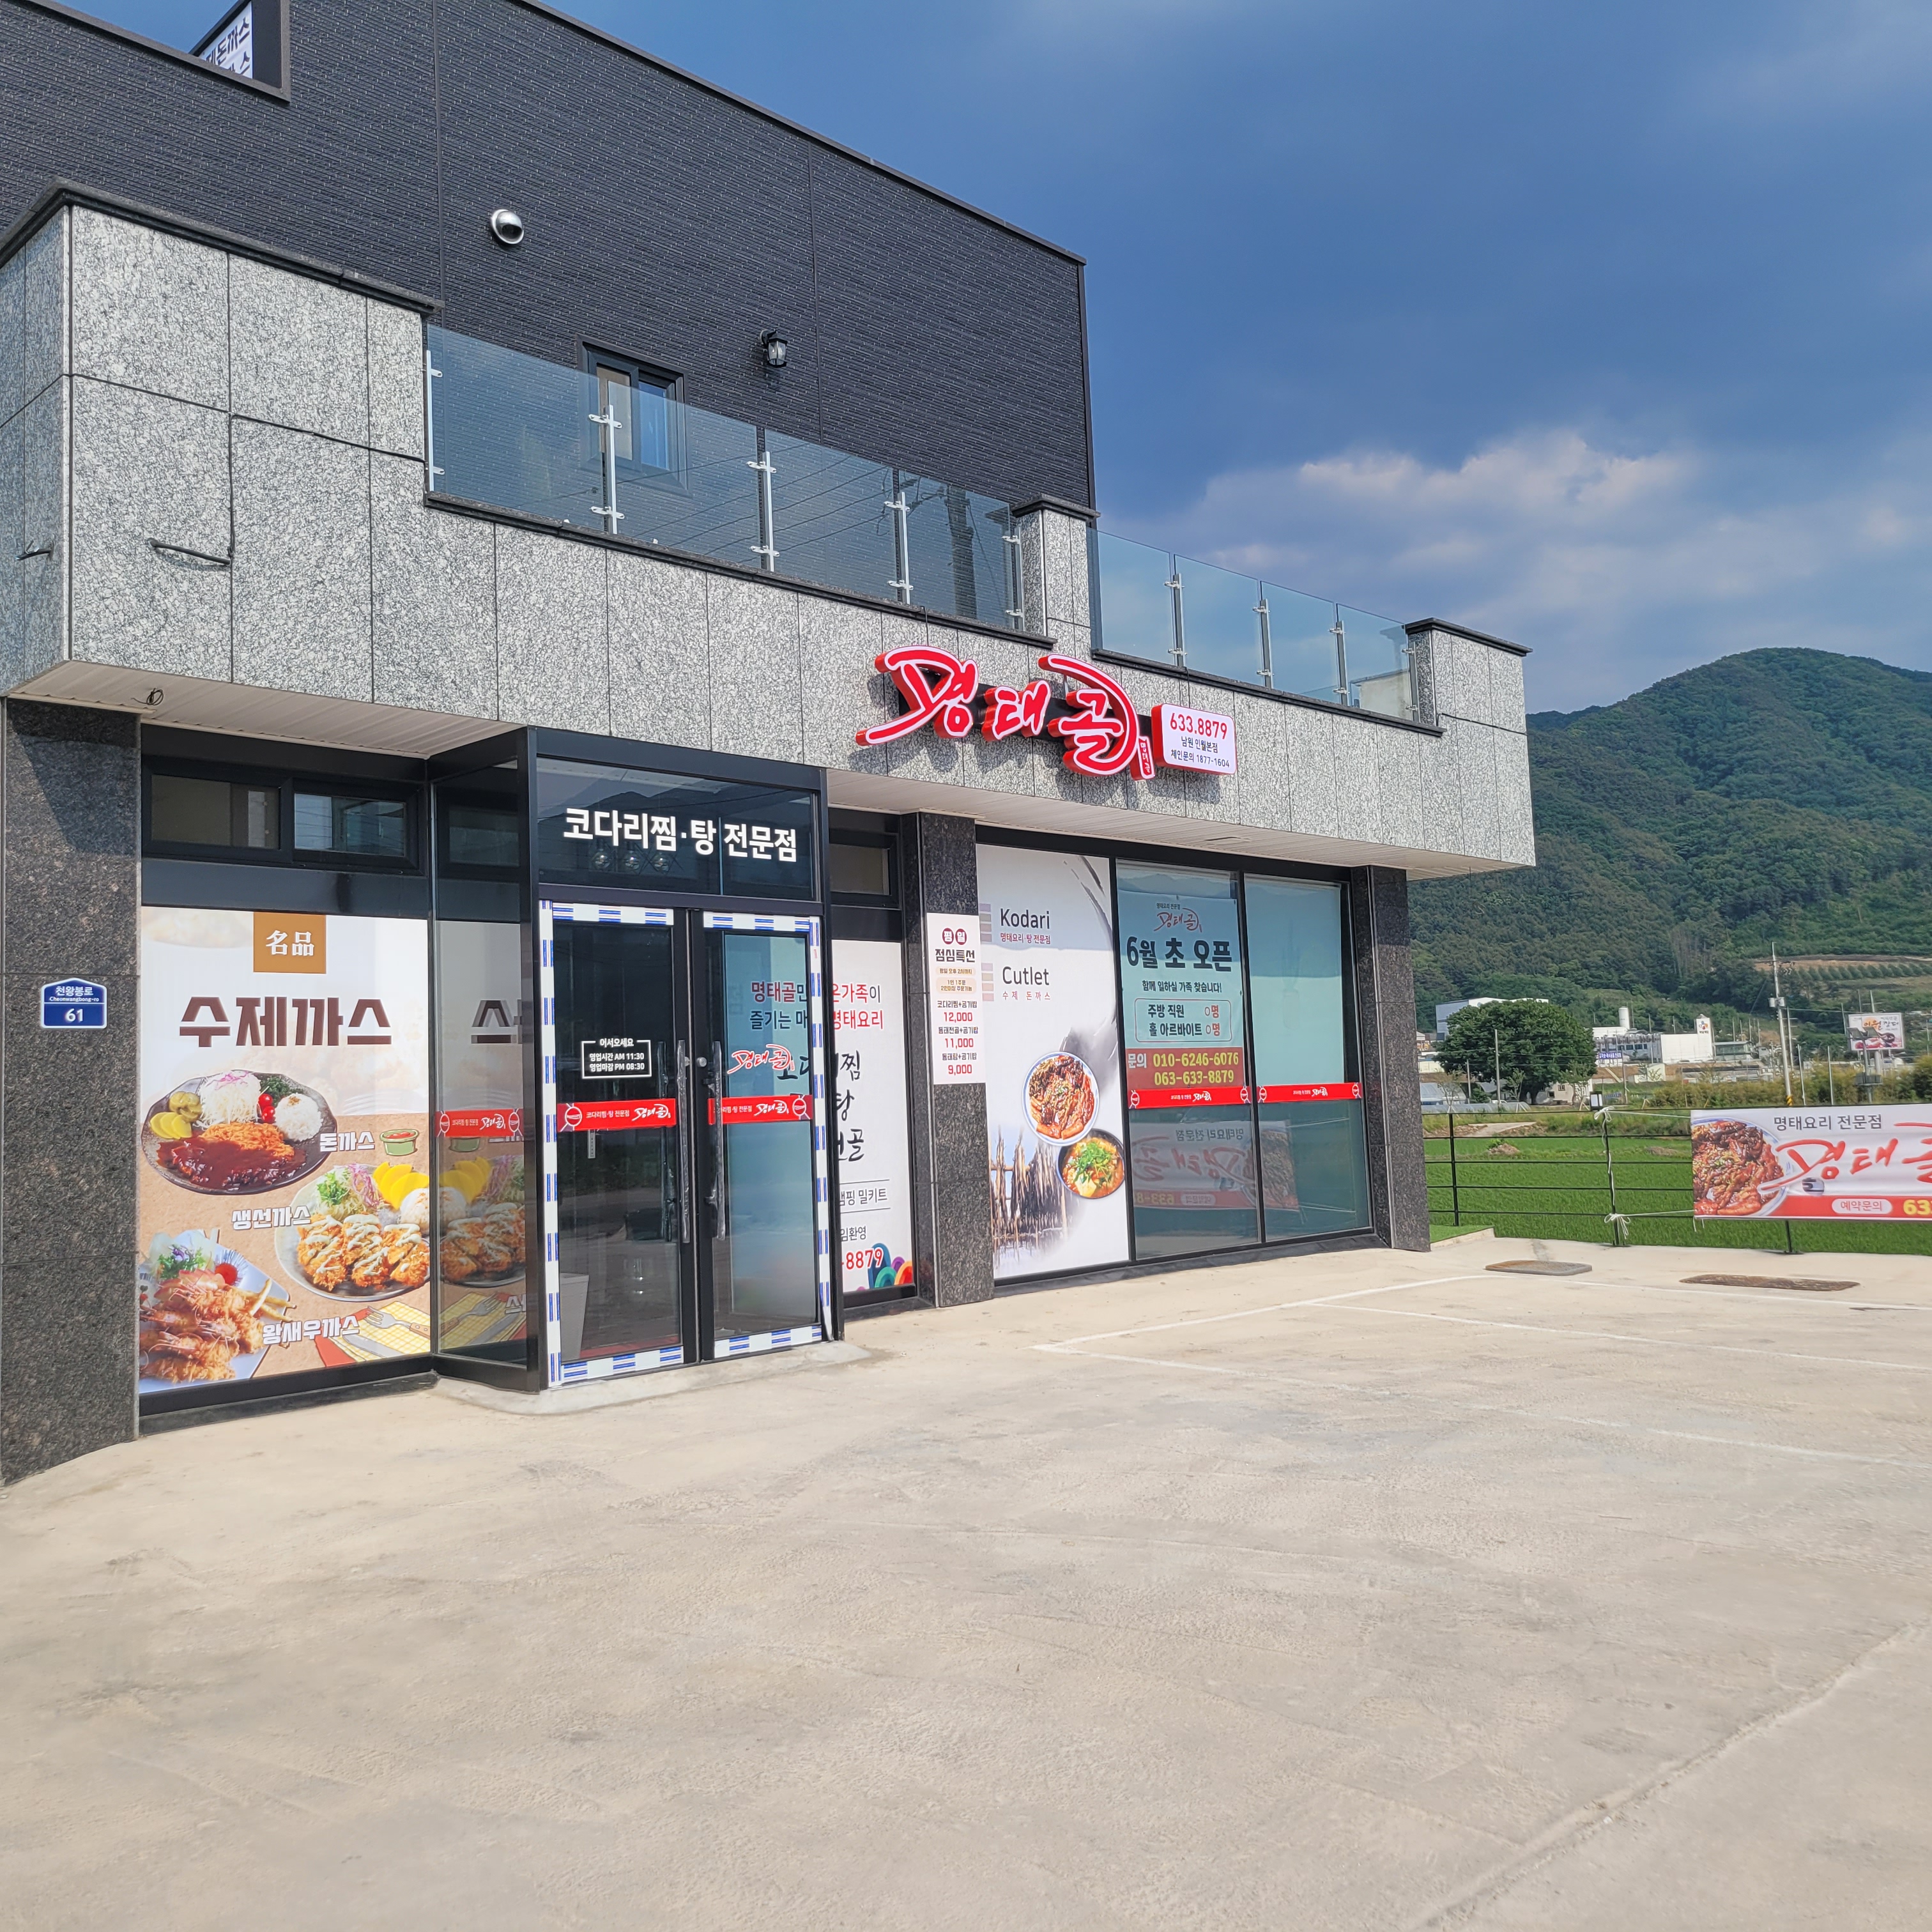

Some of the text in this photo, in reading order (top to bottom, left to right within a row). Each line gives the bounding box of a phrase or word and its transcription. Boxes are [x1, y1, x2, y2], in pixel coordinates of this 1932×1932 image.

[855, 645, 1138, 776] 명태골
[1170, 712, 1227, 740] 633.8879
[1181, 736, 1218, 754] 남원 인월본점
[1170, 749, 1230, 768] 체인문의 1877-1604
[724, 823, 797, 862] 전문점
[1000, 908, 1050, 930] Kodari
[266, 930, 315, 957] 名品
[1033, 935, 1051, 945] 전문점
[935, 948, 976, 963] 점심특선
[1126, 936, 1232, 972] 6월 초 오픈
[1002, 966, 1050, 986] Cutlet
[56, 986, 94, 997] 천왕봉로
[1142, 979, 1222, 993] 함께 일하실 가족 찾습니다!
[1002, 991, 1051, 1000] 수제 돈까스
[65, 1008, 84, 1022] 61
[944, 1011, 973, 1023] 12,000
[1147, 1004, 1165, 1018] 주방
[1167, 1004, 1185, 1018] 직원
[179, 997, 392, 1048] 수제까스
[749, 1010, 792, 1030] 즐기는
[1149, 1022, 1158, 1037] 홀
[1160, 1022, 1203, 1037] 아르바이트
[599, 1038, 634, 1048] 어서오세요
[944, 1038, 974, 1050] 11,000
[589, 1052, 614, 1062] 영업시간
[625, 1052, 645, 1061] 11:30
[727, 1044, 792, 1074] 명태골
[1128, 1052, 1239, 1069] 문의 010-6246-6076
[589, 1062, 614, 1073] 영업마감
[625, 1062, 645, 1071] 08:30
[947, 1064, 972, 1076] 9,000
[1154, 1070, 1234, 1086] 063-633-8879
[1773, 1114, 1882, 1131] 명태요리 전문점
[319, 1131, 376, 1153] 돈까스
[858, 1188, 888, 1205] 밀키트
[1840, 1199, 1932, 1215] 예약문의 63
[231, 1204, 312, 1230] 생선까스
[263, 1315, 362, 1346] 왕새우까스
